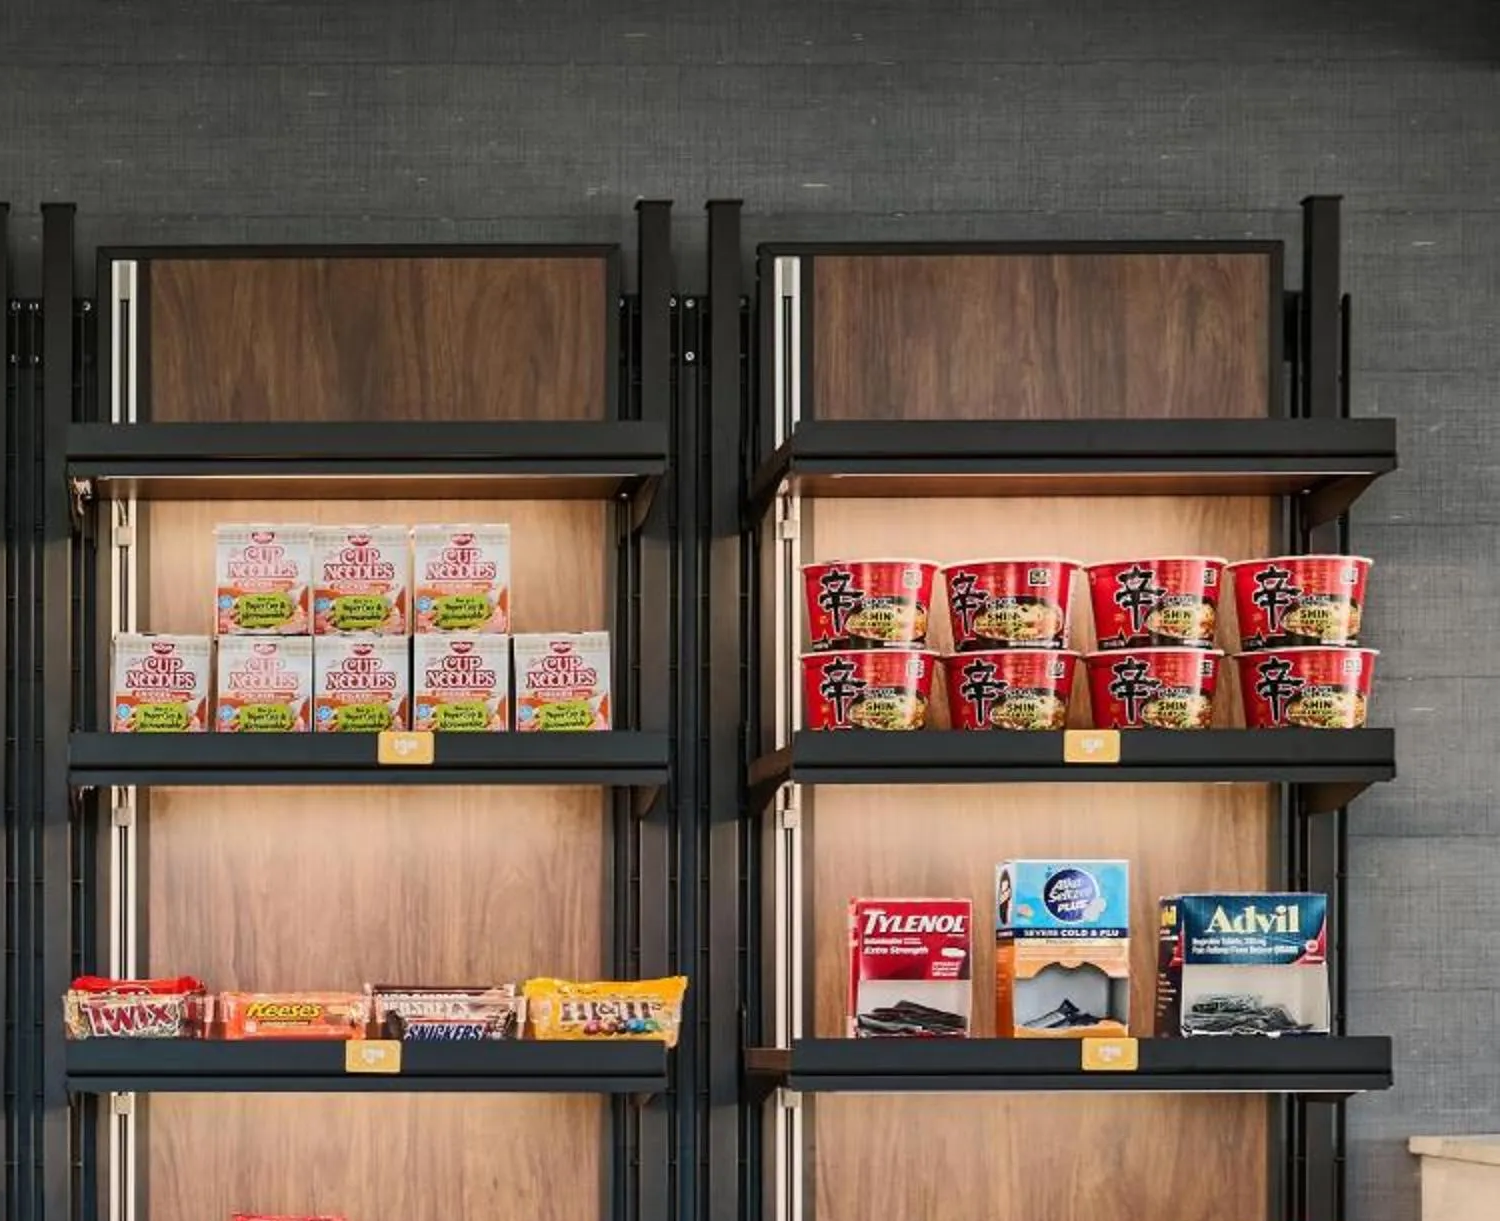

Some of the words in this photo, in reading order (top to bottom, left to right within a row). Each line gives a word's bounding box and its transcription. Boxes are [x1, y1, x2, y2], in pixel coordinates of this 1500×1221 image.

[340, 547, 380, 564] CUP
[442, 547, 482, 563] CUP
[324, 562, 394, 581] NOODLES
[426, 562, 496, 580] NOODLES
[1300, 610, 1329, 619] SHIN
[143, 656, 183, 673] CUP
[342, 657, 382, 673] CUP
[442, 656, 481, 672] CUP
[542, 656, 582, 672] CUP
[126, 671, 196, 689] NOODLES
[326, 671, 396, 690] NOODLES
[426, 670, 496, 688] NOODLES
[526, 668, 597, 688] NOODLES
[866, 703, 896, 711] SHIN
[1007, 703, 1036, 712] SHIN
[1158, 701, 1187, 710] SHIN
[1302, 700, 1332, 710] SHIN
[863, 909, 964, 935] TYLENOL
[1204, 904, 1300, 934] Advil
[1060, 929, 1089, 937] COLD
[1100, 929, 1119, 937] FLU
[404, 1025, 483, 1040] SNICKERS
